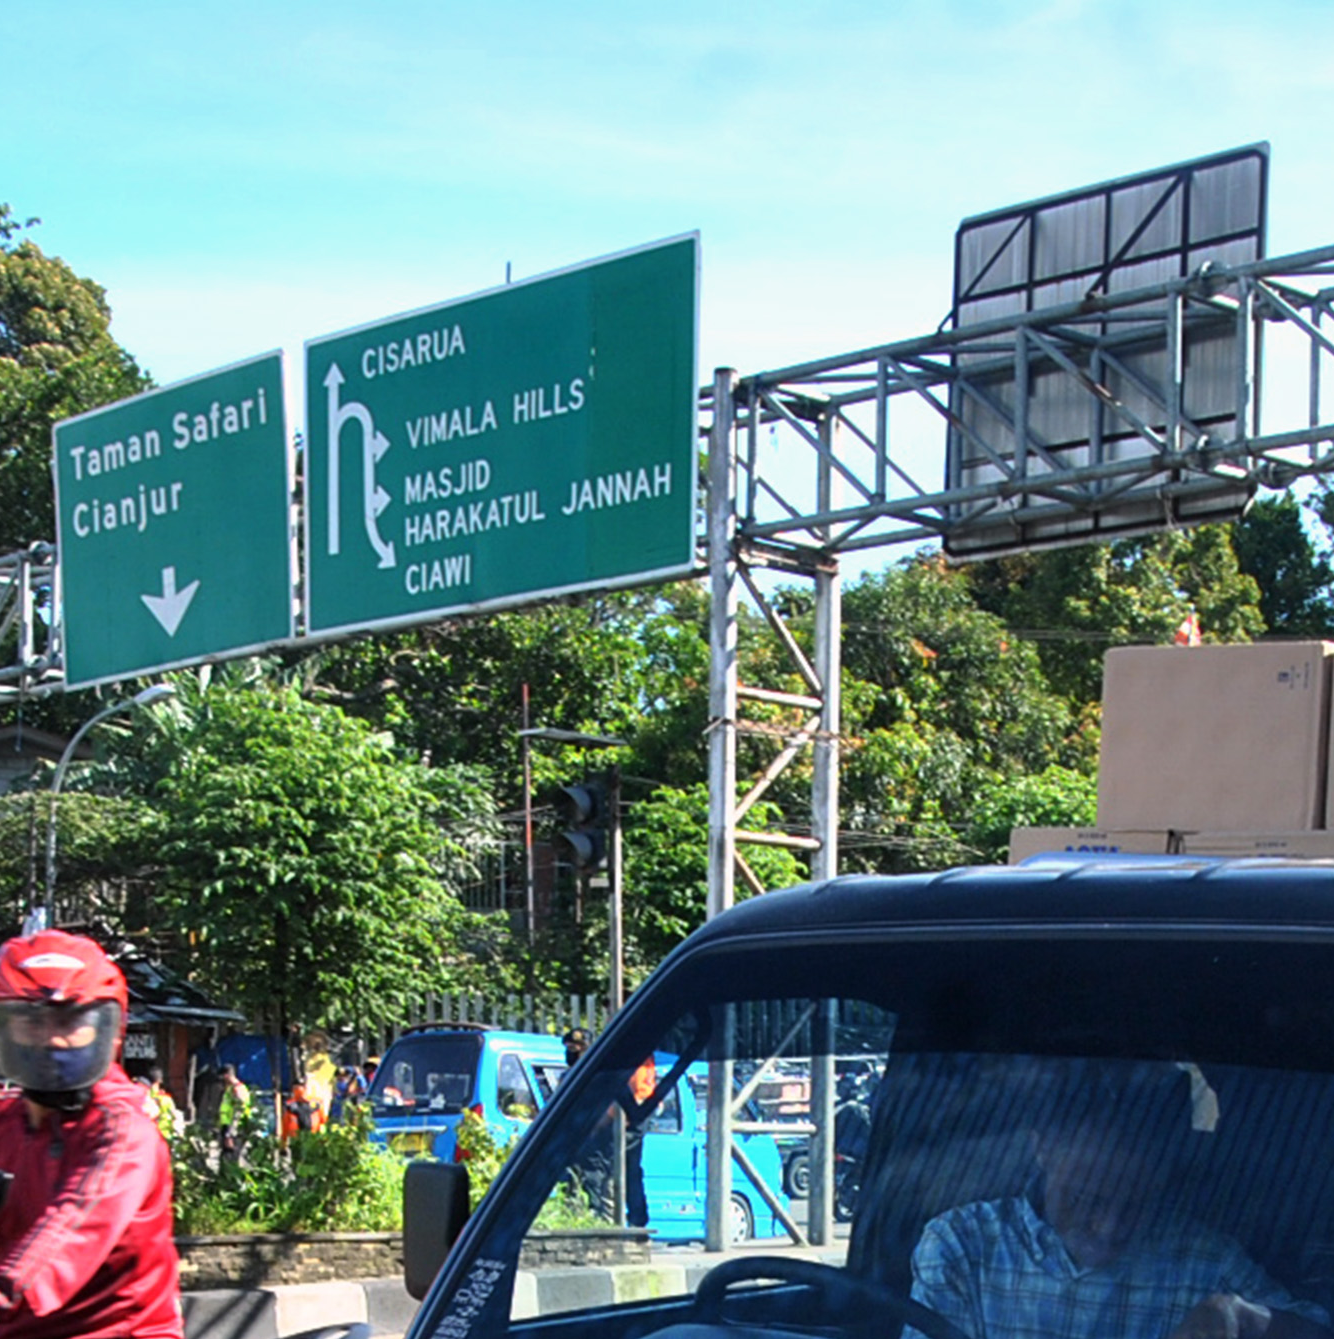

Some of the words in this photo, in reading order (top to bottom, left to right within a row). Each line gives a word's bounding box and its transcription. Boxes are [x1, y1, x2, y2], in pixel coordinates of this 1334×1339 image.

[361, 325, 466, 379] CISARUA
[69, 430, 161, 480] Taman
[171, 388, 267, 449] Safari
[405, 401, 498, 449] VIMALA
[513, 378, 585, 424] HILLS
[72, 482, 183, 538] Cianjur
[404, 460, 491, 505] MASJID
[404, 490, 545, 547] HARAKATUL
[562, 463, 672, 515] JANNAH
[405, 554, 472, 595] CIAWI
